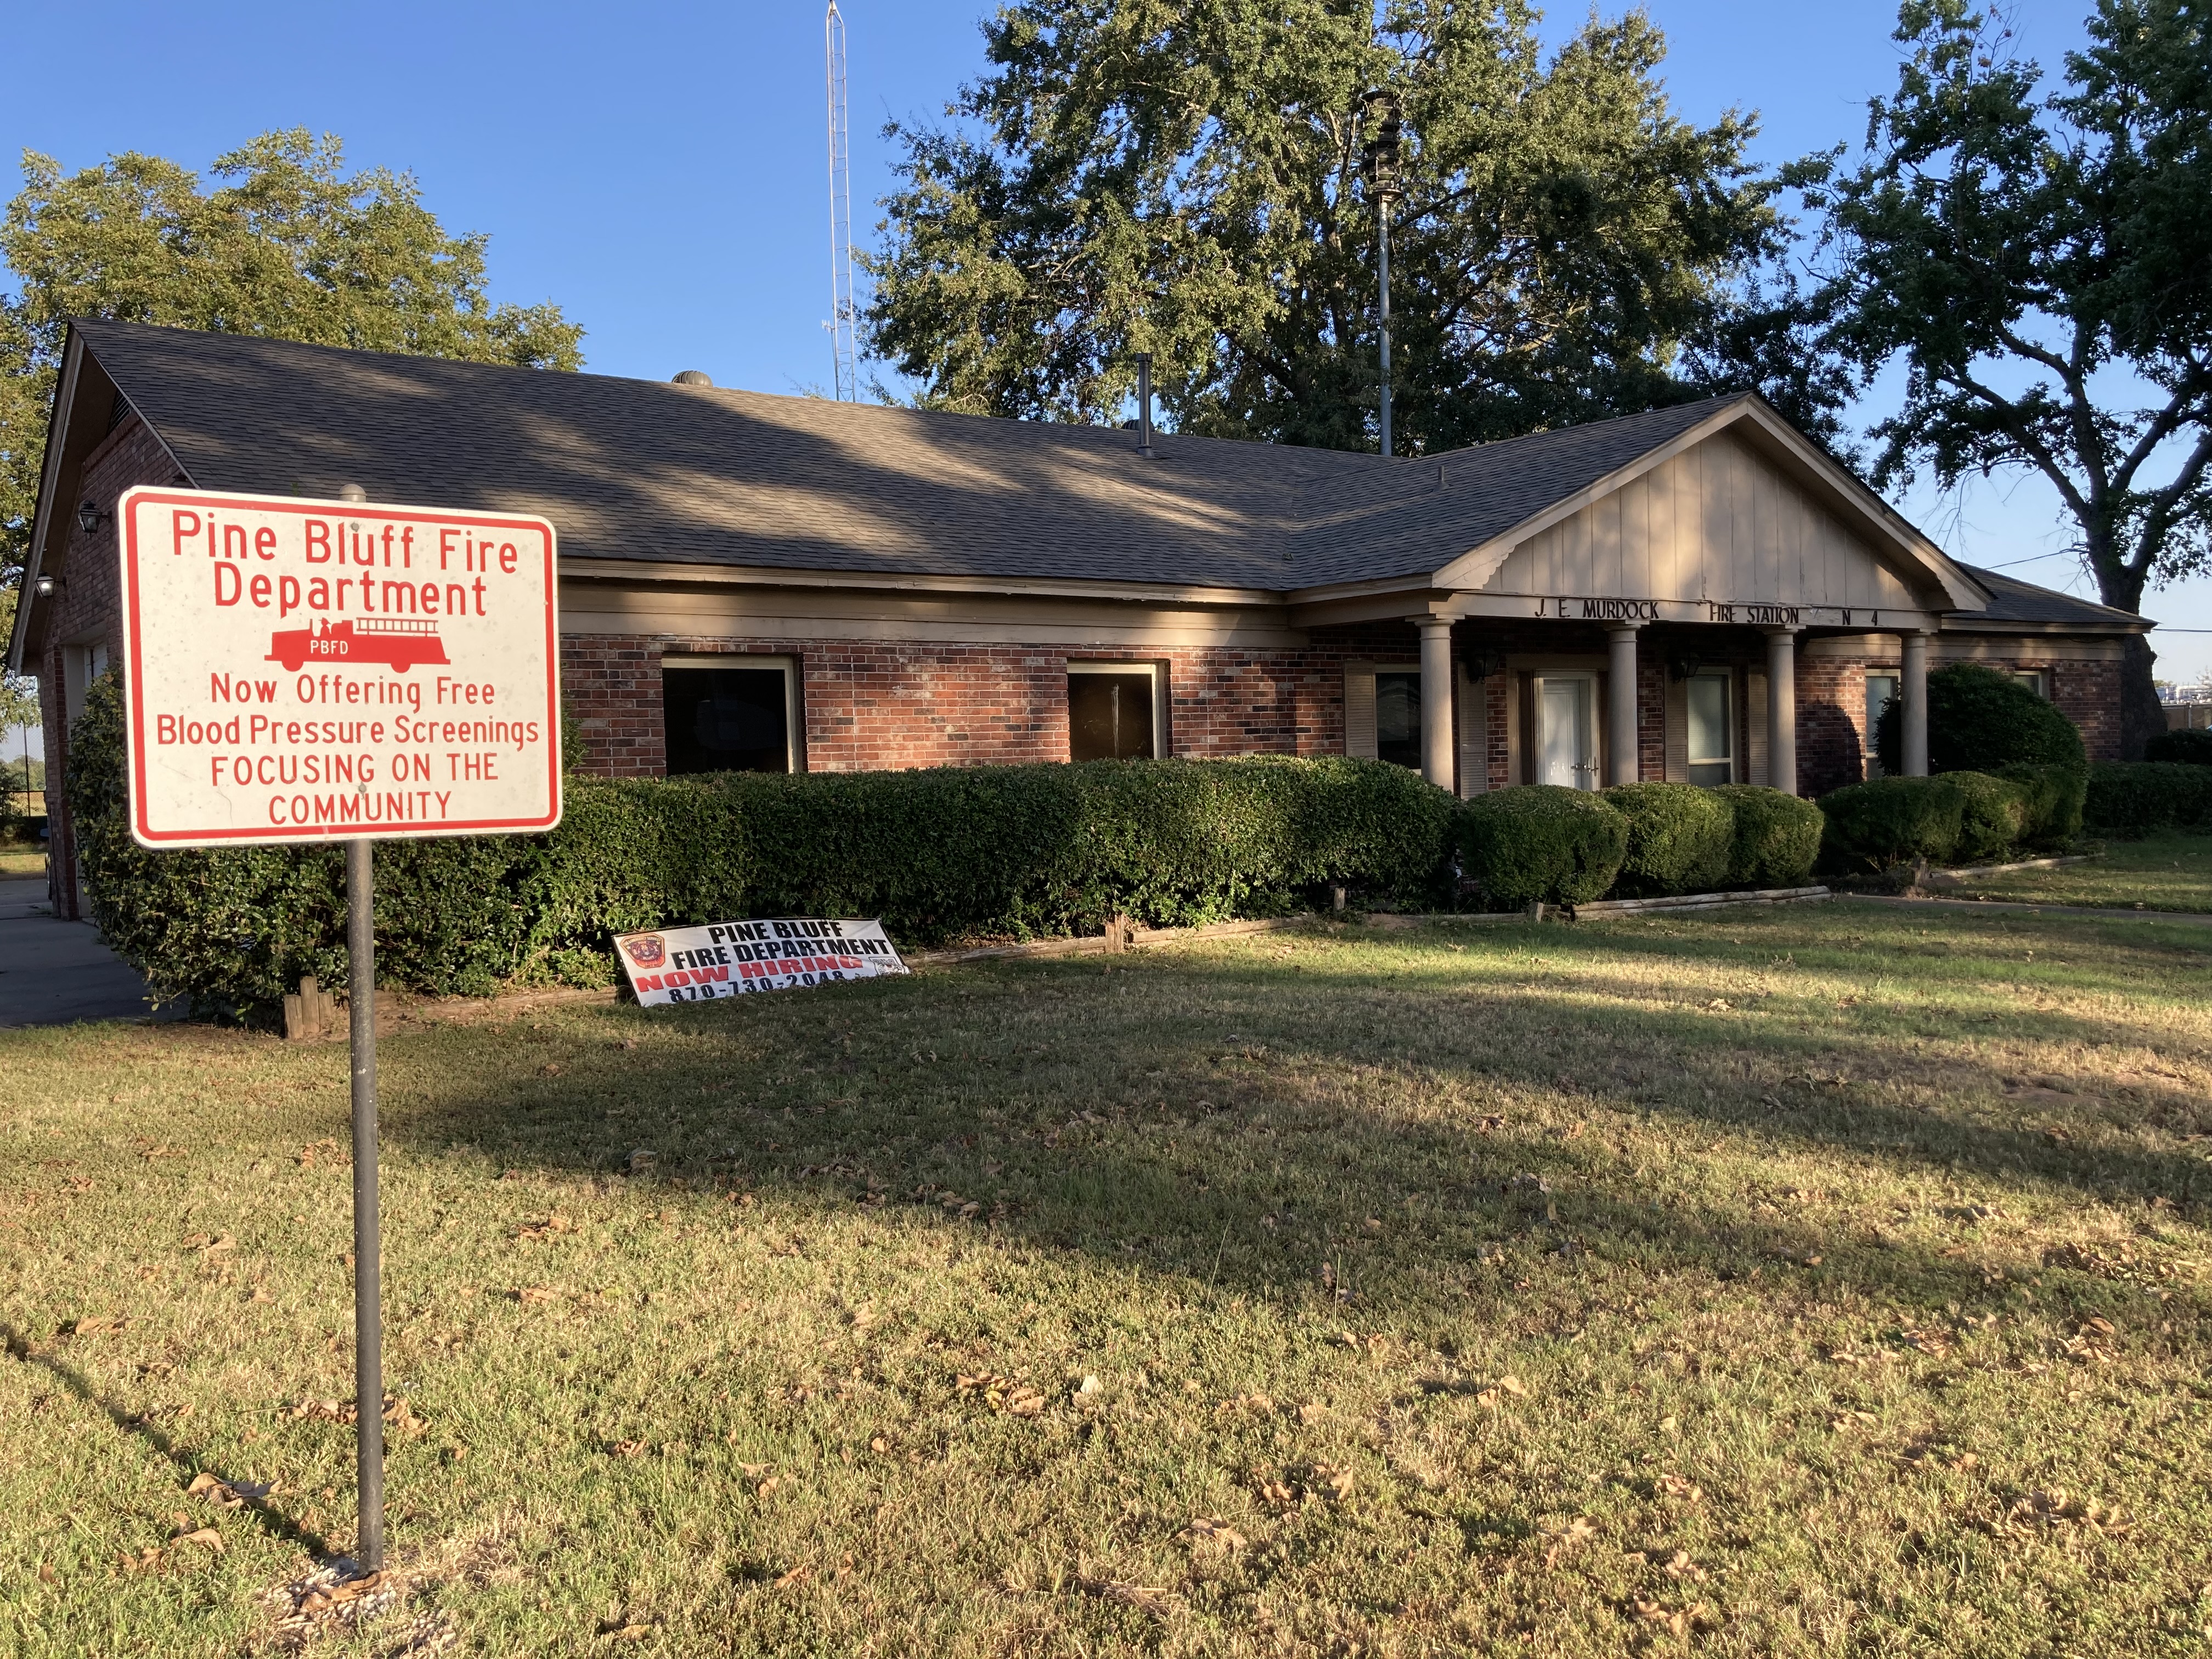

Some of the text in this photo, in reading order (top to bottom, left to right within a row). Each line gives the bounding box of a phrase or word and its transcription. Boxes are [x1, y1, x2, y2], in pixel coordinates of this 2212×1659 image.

[173, 510, 517, 574] Pine Bluff Fire
[214, 561, 487, 618] Department
[1534, 599, 1547, 617] J.
[1558, 599, 1570, 617] E.
[1583, 600, 1659, 619] MURDOCK
[1709, 604, 1737, 623] FIRE
[1747, 606, 1799, 624] STATION
[1871, 610, 1878, 626] 4
[310, 640, 349, 655] PBFD
[211, 673, 495, 714] Now Offering Free
[157, 714, 539, 752] Blood Pressure Screenings
[211, 753, 498, 786] FOCUSING ON THE
[269, 791, 452, 825] COMMUNITY
[708, 921, 843, 944] PINE BLUFF
[670, 939, 890, 969] FIRE DEPARTMENT
[635, 955, 864, 992] NOW HIRING
